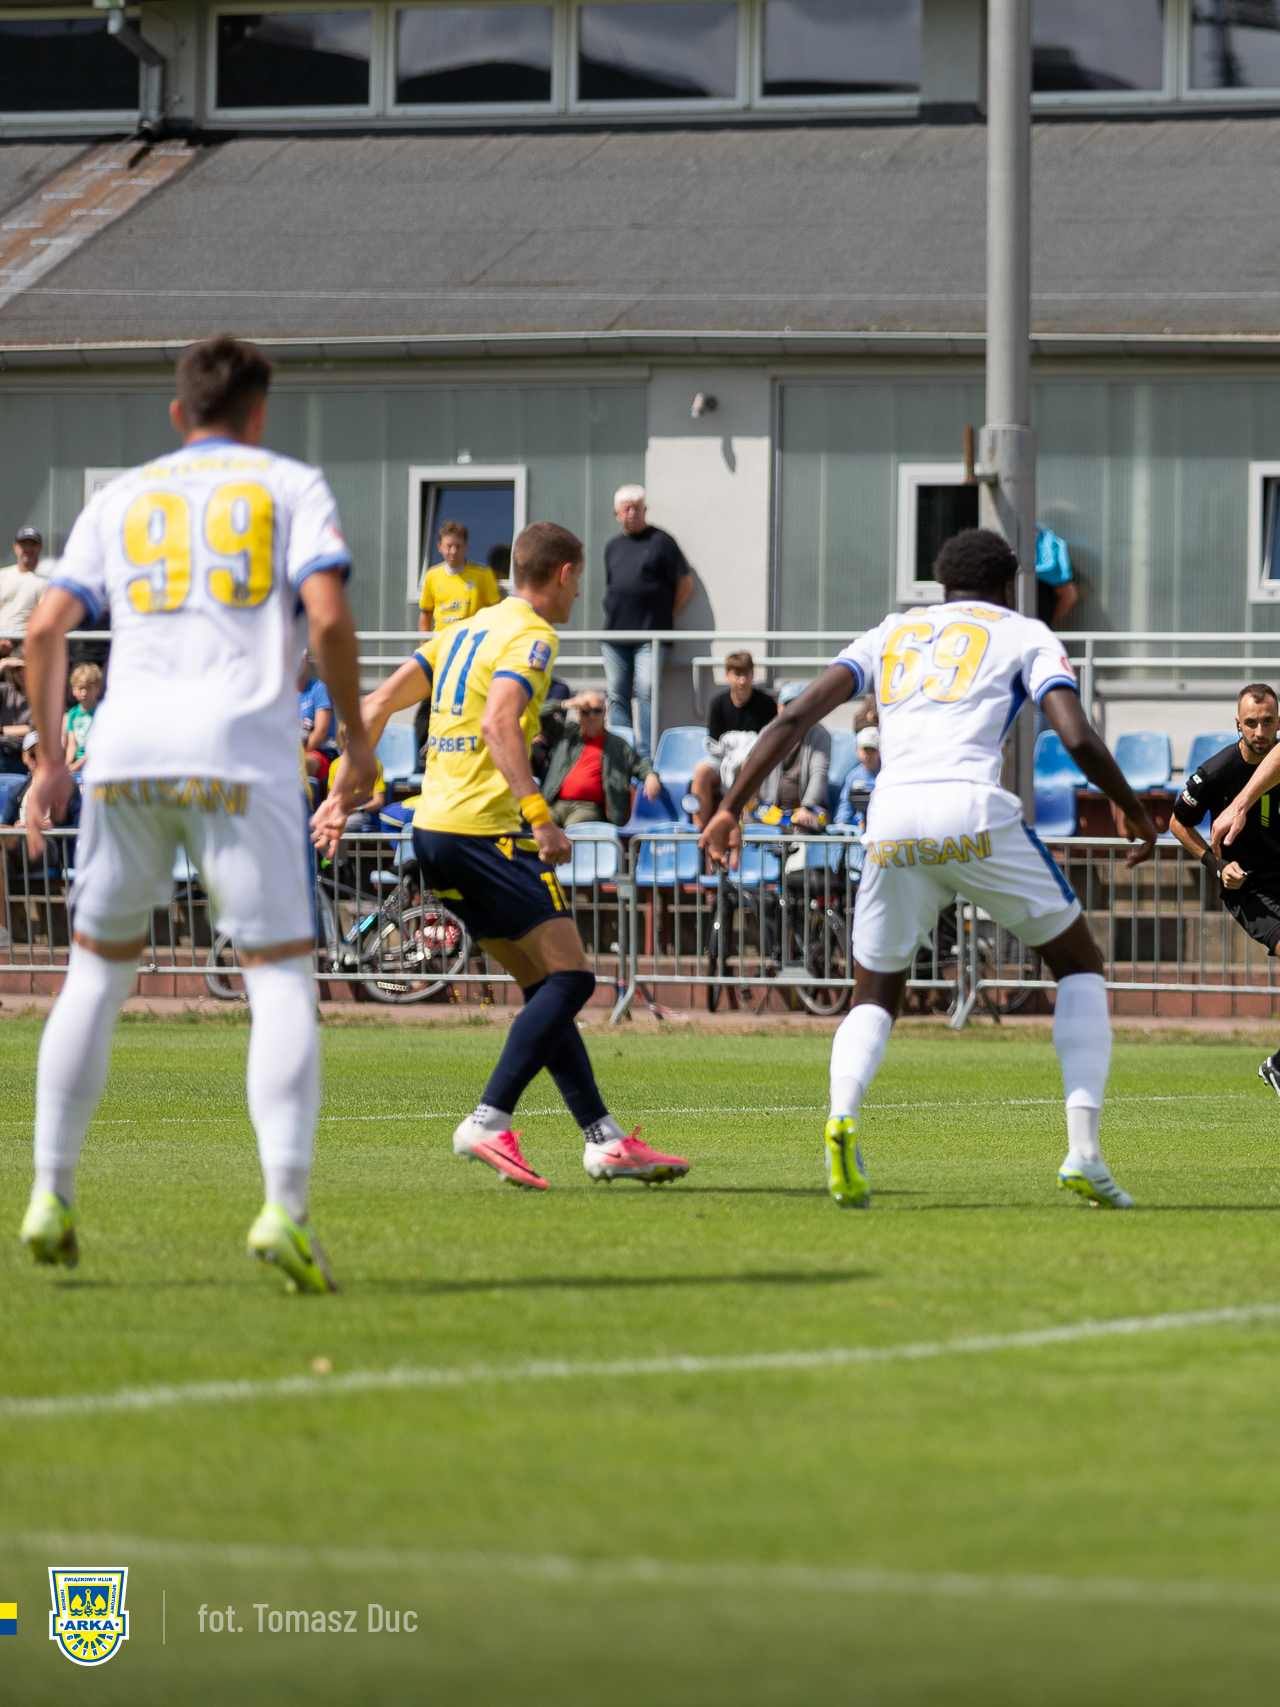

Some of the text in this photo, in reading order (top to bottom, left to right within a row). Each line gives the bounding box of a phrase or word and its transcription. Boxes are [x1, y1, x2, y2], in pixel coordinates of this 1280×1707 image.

[121, 481, 274, 616] 99
[432, 628, 490, 716] 11
[879, 622, 991, 706] 69
[868, 830, 992, 868] ARTSANI
